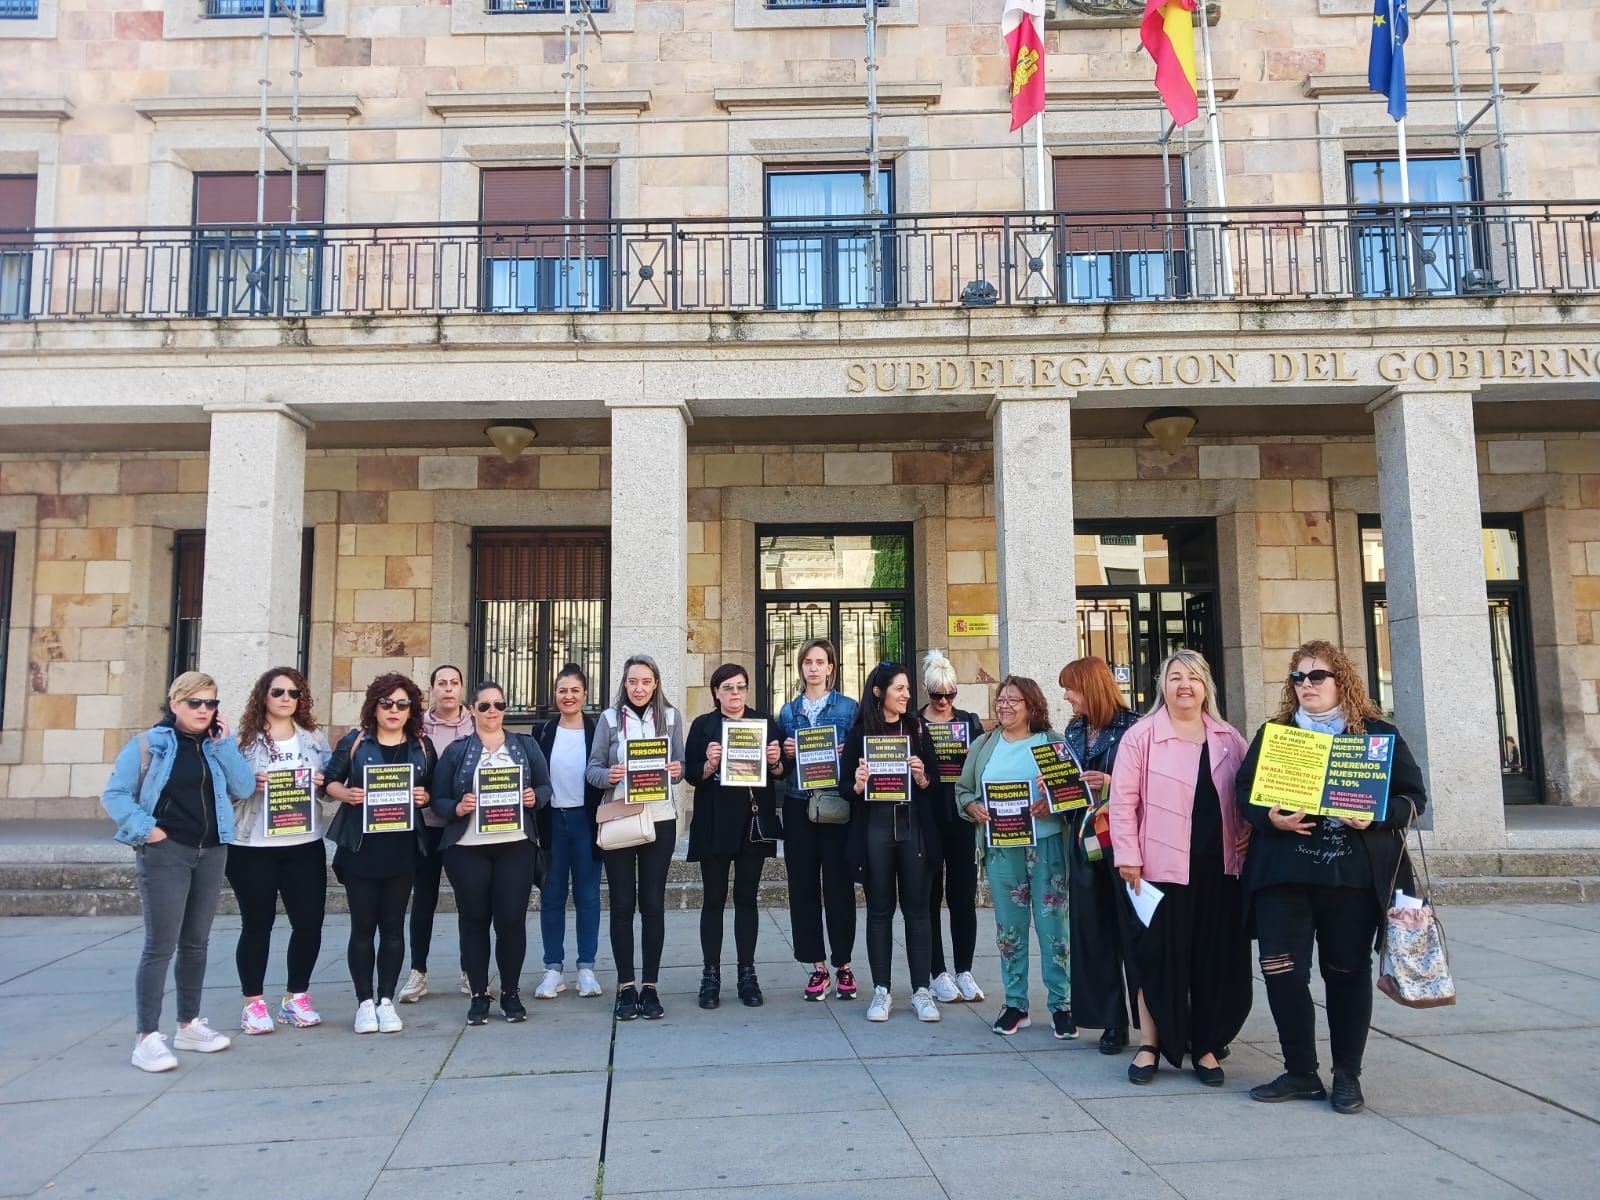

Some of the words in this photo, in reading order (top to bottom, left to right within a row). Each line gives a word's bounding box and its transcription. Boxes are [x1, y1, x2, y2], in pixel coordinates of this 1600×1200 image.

[847, 353, 1238, 393] SUBDELEGACION
[1269, 352, 1358, 382] DEL
[1284, 729, 1314, 740] ZAMORA
[1331, 761, 1380, 770] QUEREMOS
[1284, 769, 1310, 778] DECRETO
[1330, 770, 1370, 778] NUESTRO
